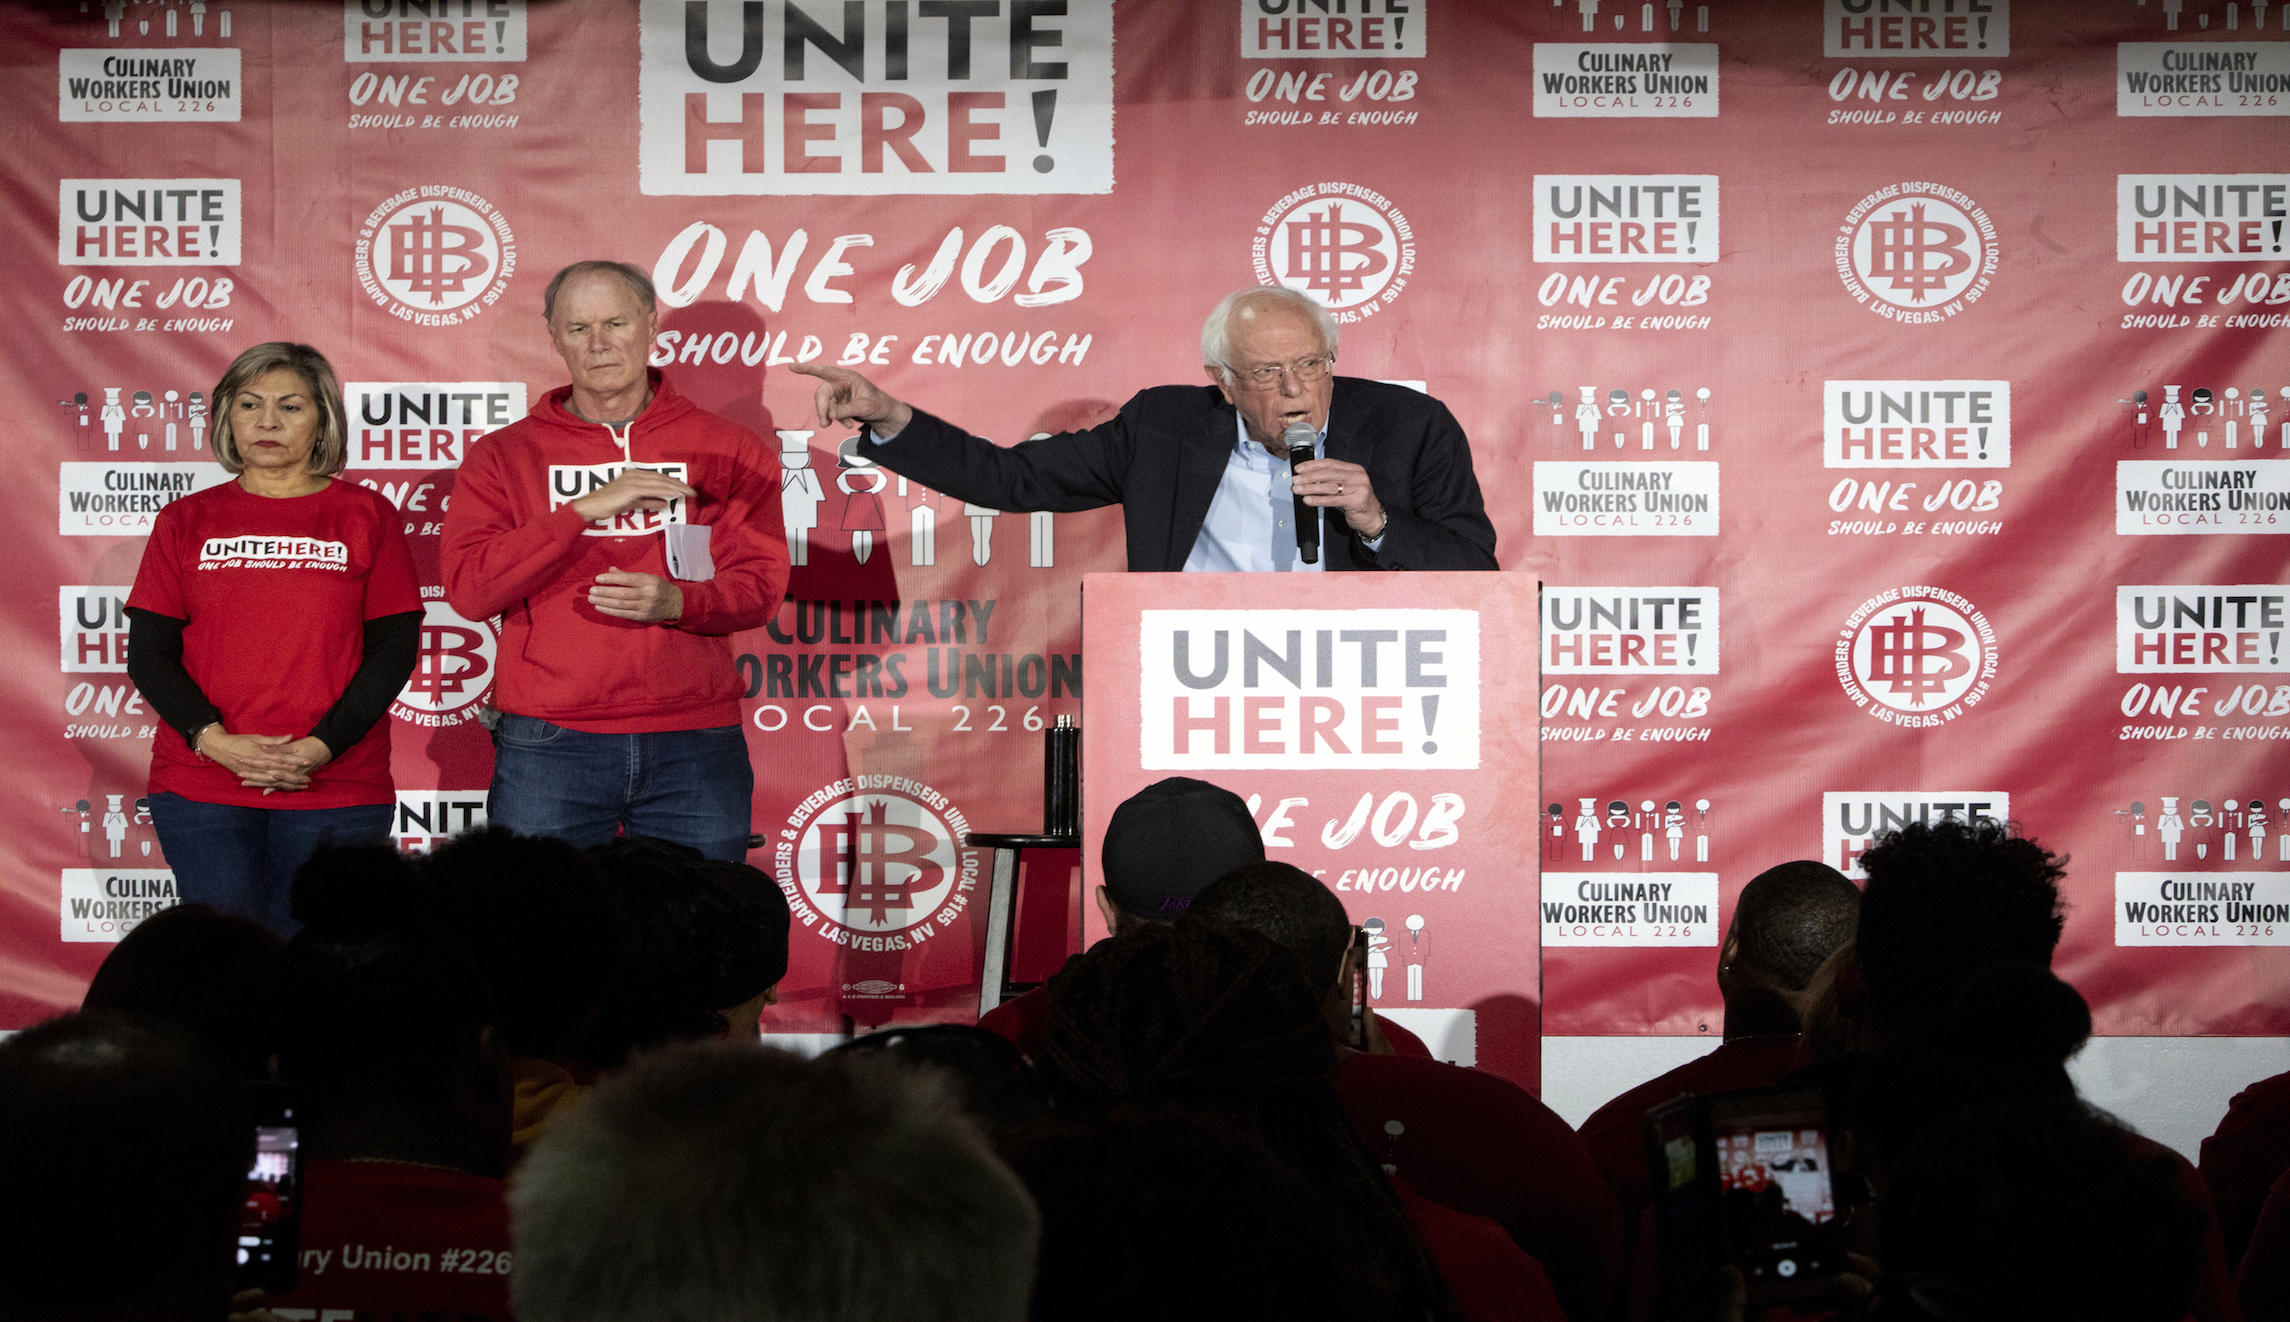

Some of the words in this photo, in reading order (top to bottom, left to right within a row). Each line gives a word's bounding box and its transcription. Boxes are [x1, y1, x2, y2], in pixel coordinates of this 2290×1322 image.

[361, 21, 505, 54] HERE!
[685, 0, 1068, 83] UNITE
[1259, 17, 1404, 49] HERE!
[1841, 16, 1988, 49] HERE!
[104, 56, 195, 77] CULINARY
[1579, 48, 1676, 72] CULINARY
[2163, 50, 2257, 71] CULINARY
[69, 78, 160, 99] WORKERS
[168, 78, 229, 98] UNION
[349, 73, 434, 107] ONE
[441, 74, 519, 105] JOB
[1245, 68, 1332, 104] ONE
[1339, 70, 1418, 102] JOB
[1543, 73, 1636, 94] WORKERS
[1645, 73, 1707, 94] UNION
[1828, 70, 1913, 103] ONE
[1922, 70, 2001, 101] JOB
[2127, 72, 2221, 93] WORKERS
[2228, 69, 2290, 92] UNION
[85, 101, 162, 112] LOCAL
[178, 101, 215, 112] 226
[1560, 96, 1638, 107] LOCAL
[1655, 96, 1692, 107] 226
[2144, 95, 2223, 106] LOCAL
[2239, 95, 2277, 106] 226
[348, 114, 415, 129] SHOULD
[421, 115, 443, 128] BE
[450, 114, 519, 129] ENOUGH
[685, 89, 1057, 173] HERE!
[1245, 111, 1312, 125] SHOULD
[1318, 112, 1342, 124] BE
[1347, 111, 1418, 125] ENOUGH
[1828, 110, 1896, 124] SHOULD
[1902, 111, 1924, 124] BE
[1931, 110, 2001, 124] ENOUGH
[77, 190, 223, 222] UNITE
[365, 188, 418, 228] BEVERAGE
[420, 185, 493, 213] DISPENSERS
[1551, 186, 1701, 218] UNITE
[1845, 184, 1899, 225] BEVERAGE
[1902, 181, 1975, 210] DISPENSERS
[2135, 185, 2287, 218] UNITE
[360, 229, 374, 237] &
[489, 211, 514, 244] UNION
[1551, 221, 1697, 254] HERE!
[1840, 225, 1854, 234] &
[1971, 207, 1997, 240] UNION
[2135, 220, 2282, 253] HERE!
[76, 225, 219, 257] HERE!
[355, 239, 389, 306] BARTENDERS
[499, 245, 516, 277] LOCAL
[652, 221, 874, 312] ONE
[892, 225, 1092, 307] JOB
[1835, 236, 1870, 303] BARTENDERS
[1982, 242, 1999, 275] LOCAL
[64, 275, 149, 311] ONE
[156, 277, 233, 309] JOB
[483, 280, 507, 306] #165
[1538, 272, 1625, 308] ONE
[1632, 274, 1711, 306] JOB
[1965, 277, 1990, 303] #165
[2122, 272, 2209, 307] ONE
[2217, 272, 2290, 305] JOB
[63, 317, 129, 331] SHOULD
[135, 318, 158, 331] BE
[164, 318, 234, 332] ENOUGH
[389, 303, 413, 321] LAS
[415, 313, 463, 326] VEGAS,
[462, 302, 481, 320] NV
[1537, 315, 1605, 329] SHOULD
[1611, 316, 1634, 329] BE
[1640, 315, 1711, 330] ENOUGH
[1870, 300, 1895, 318] LAS
[1896, 311, 1945, 323] VEGAS,
[1944, 300, 1963, 317] NV
[2121, 314, 2190, 329] SHOULD
[2196, 315, 2220, 328] BE
[2225, 314, 2290, 328] ENOUGH
[648, 328, 826, 371] SHOULD
[837, 333, 898, 366] BE
[912, 331, 1092, 368] ENOUGH
[362, 393, 508, 426] UNITE
[1842, 392, 1992, 424] UNITE
[1842, 427, 1988, 460] HERE!
[105, 470, 195, 491] CULINARY
[1579, 469, 1672, 490] CULINARY
[2162, 469, 2256, 489] CULINARY
[70, 492, 162, 515] WORKERS
[1543, 491, 1636, 512] WORKERS
[1645, 492, 1707, 512] UNION
[1829, 478, 1916, 513] ONE
[1923, 480, 2002, 512] JOB
[2126, 491, 2221, 511] WORKERS
[1560, 514, 1638, 526] LOCAL
[1655, 515, 1692, 526] 226
[1828, 521, 1896, 535] SHOULD
[1902, 521, 1925, 534] BE
[1931, 521, 2002, 535] ENOUGH
[2143, 513, 2222, 525] LOCAL
[2239, 513, 2276, 524] 226
[198, 561, 219, 570] ONE
[221, 559, 242, 568] JOB
[244, 560, 286, 568] SHOULD
[288, 561, 303, 569] BE
[305, 561, 347, 572] ENOUGH
[766, 594, 996, 645] CULINARY
[1551, 598, 1701, 630] UNITE
[2135, 596, 2283, 629] UNITE
[1173, 629, 1447, 689] UNITE
[1551, 633, 1697, 666] HERE!
[2135, 632, 2279, 664] HERE!
[735, 654, 908, 699] ORKERS
[928, 648, 1082, 699] UNION
[1542, 684, 1625, 720] ONE
[1632, 686, 1711, 718] JOB
[2121, 683, 2207, 718] ONE
[64, 724, 131, 738] SHOULD
[754, 705, 912, 731] OCAL
[952, 705, 1043, 731] 226
[1173, 695, 1439, 754] HERE!
[1542, 727, 1605, 741] SHOULD
[1611, 728, 1634, 741] BE
[1640, 727, 1710, 742] ENOUGH
[787, 778, 855, 828] BEVERAGE
[857, 774, 949, 811] DISPENSERS
[781, 829, 798, 840] &
[1322, 791, 1465, 850] JOB
[776, 842, 818, 926] BARTENDERS
[958, 851, 978, 891] LOCAL
[1336, 867, 1465, 893] ENOUGH
[1578, 881, 1671, 901] CULINARY
[937, 894, 968, 926] #165
[1543, 903, 1636, 923] WORKERS
[1644, 903, 1707, 923] UNION
[818, 922, 850, 945] LAS
[852, 935, 911, 951] VEGAS,
[910, 923, 935, 944] NV
[1559, 925, 1637, 937] LOCAL
[1654, 926, 1691, 937] 226
[342, 1244, 431, 1271] Union
[440, 1248, 512, 1275] #226
